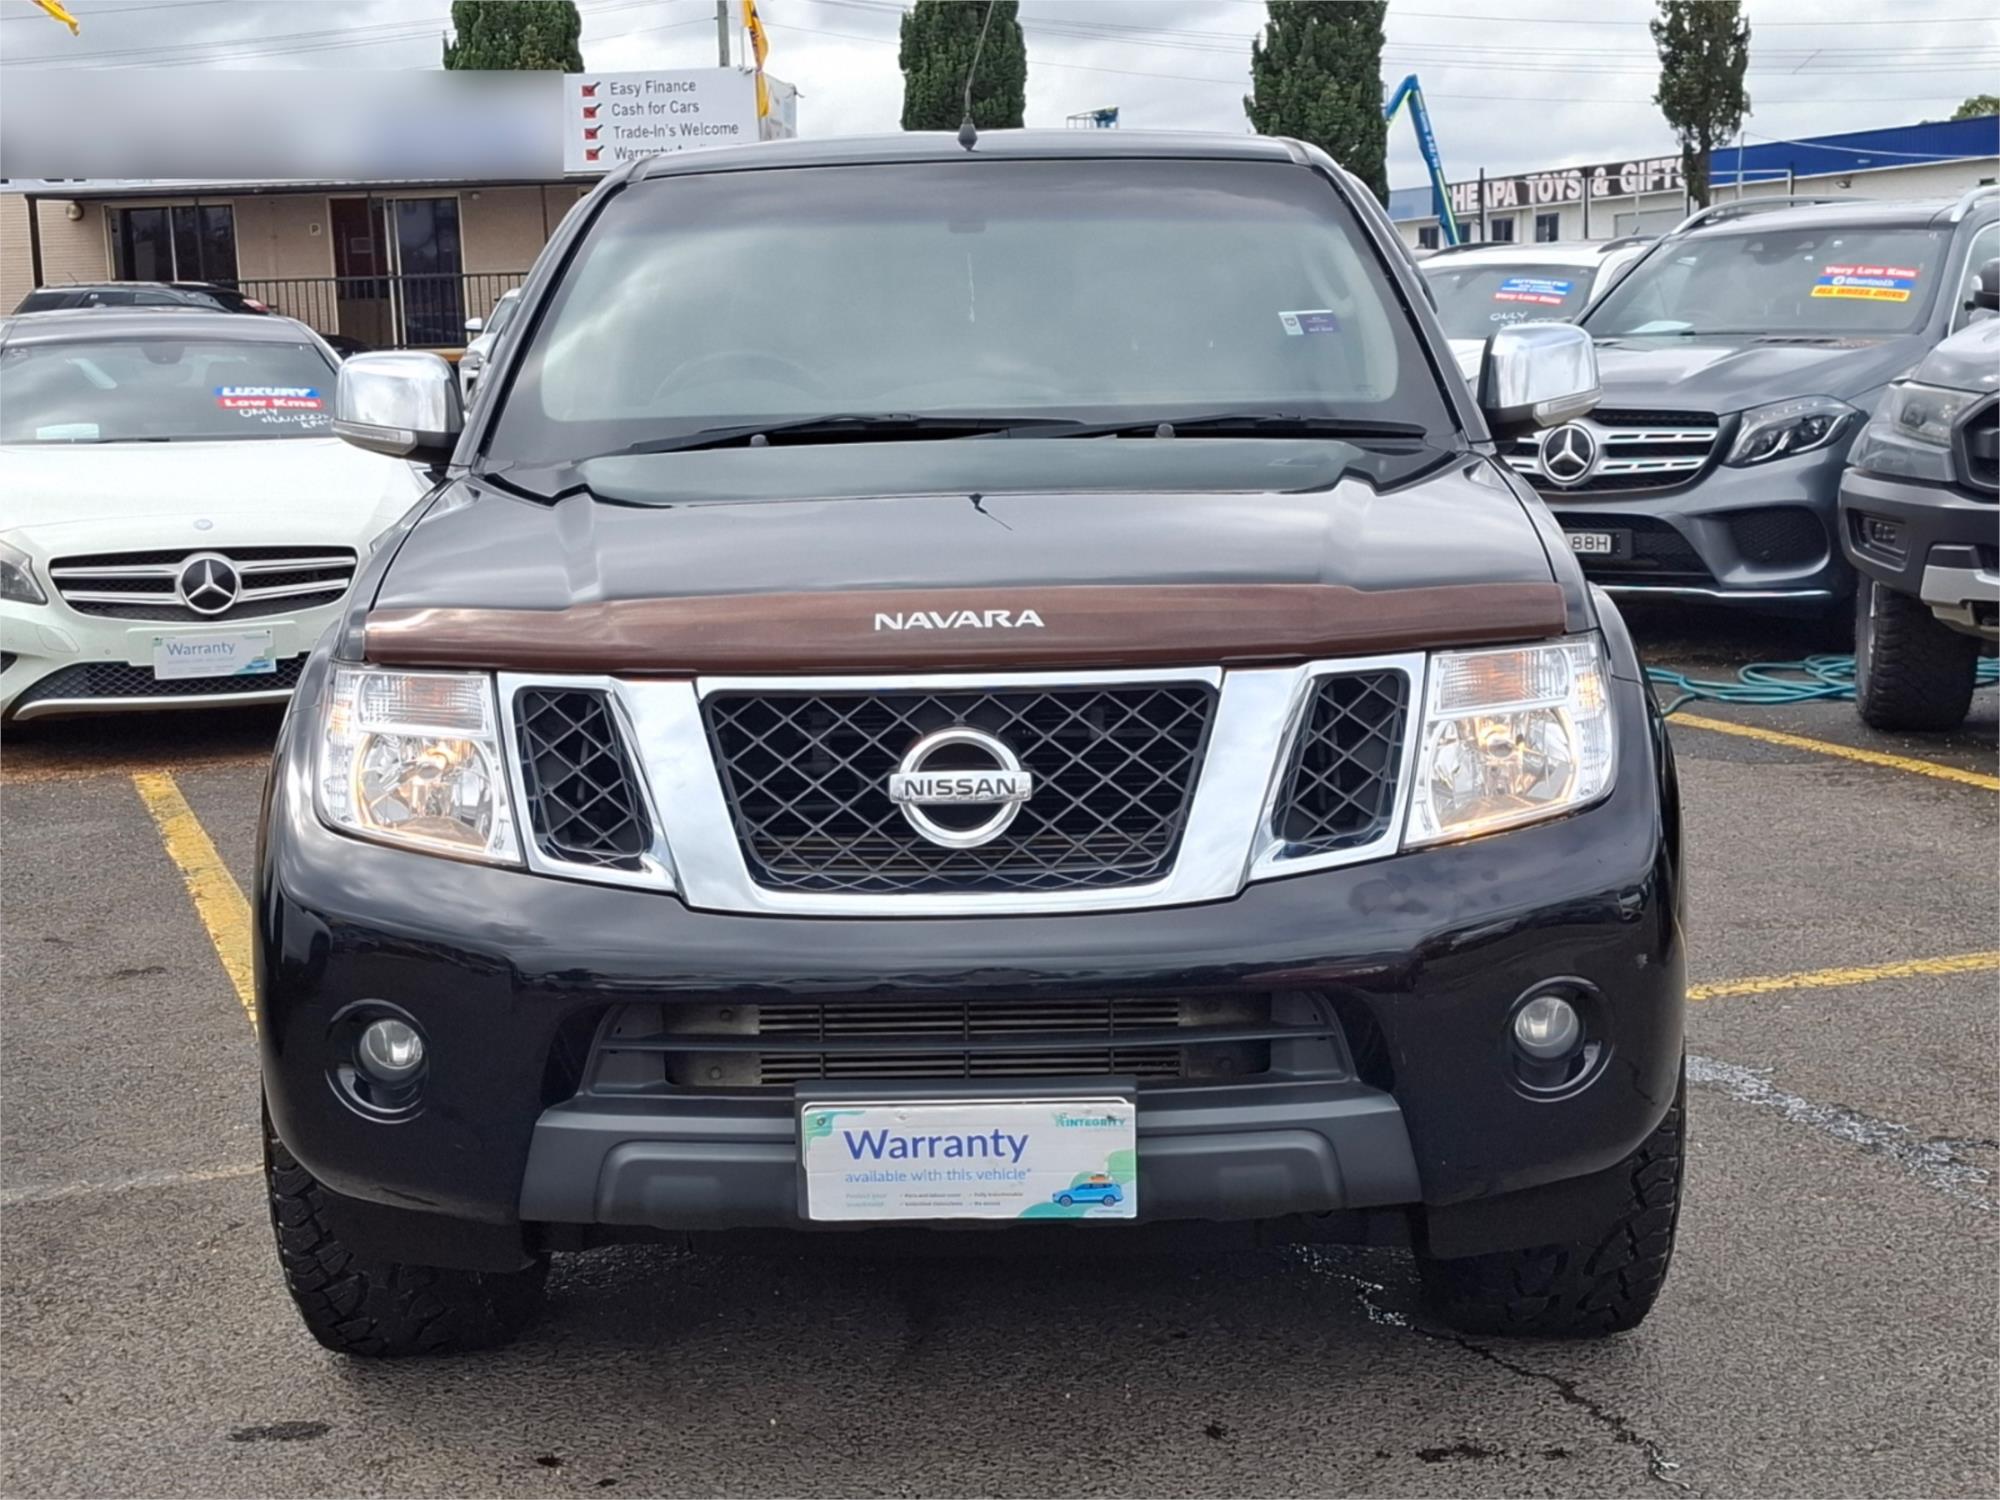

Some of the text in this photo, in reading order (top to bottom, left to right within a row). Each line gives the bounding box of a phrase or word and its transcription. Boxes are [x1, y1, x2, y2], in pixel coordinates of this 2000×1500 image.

[610, 80, 696, 98] Easy Finance
[611, 100, 700, 117] Cash for Cars
[614, 122, 739, 140] Trade-In's Welcome
[1525, 169, 1583, 202] TOYS
[1592, 166, 1610, 197] &
[222, 387, 311, 396] LUXURY
[224, 398, 267, 407] Low
[1571, 536, 1609, 551] 88H
[874, 609, 1046, 631] NAVARA
[166, 642, 236, 656] Warranty
[904, 777, 1017, 797] NISSAN
[843, 1128, 1029, 1164] Warranty
[845, 1170, 907, 1183] available
[911, 1169, 942, 1182] with
[946, 1168, 973, 1181] this
